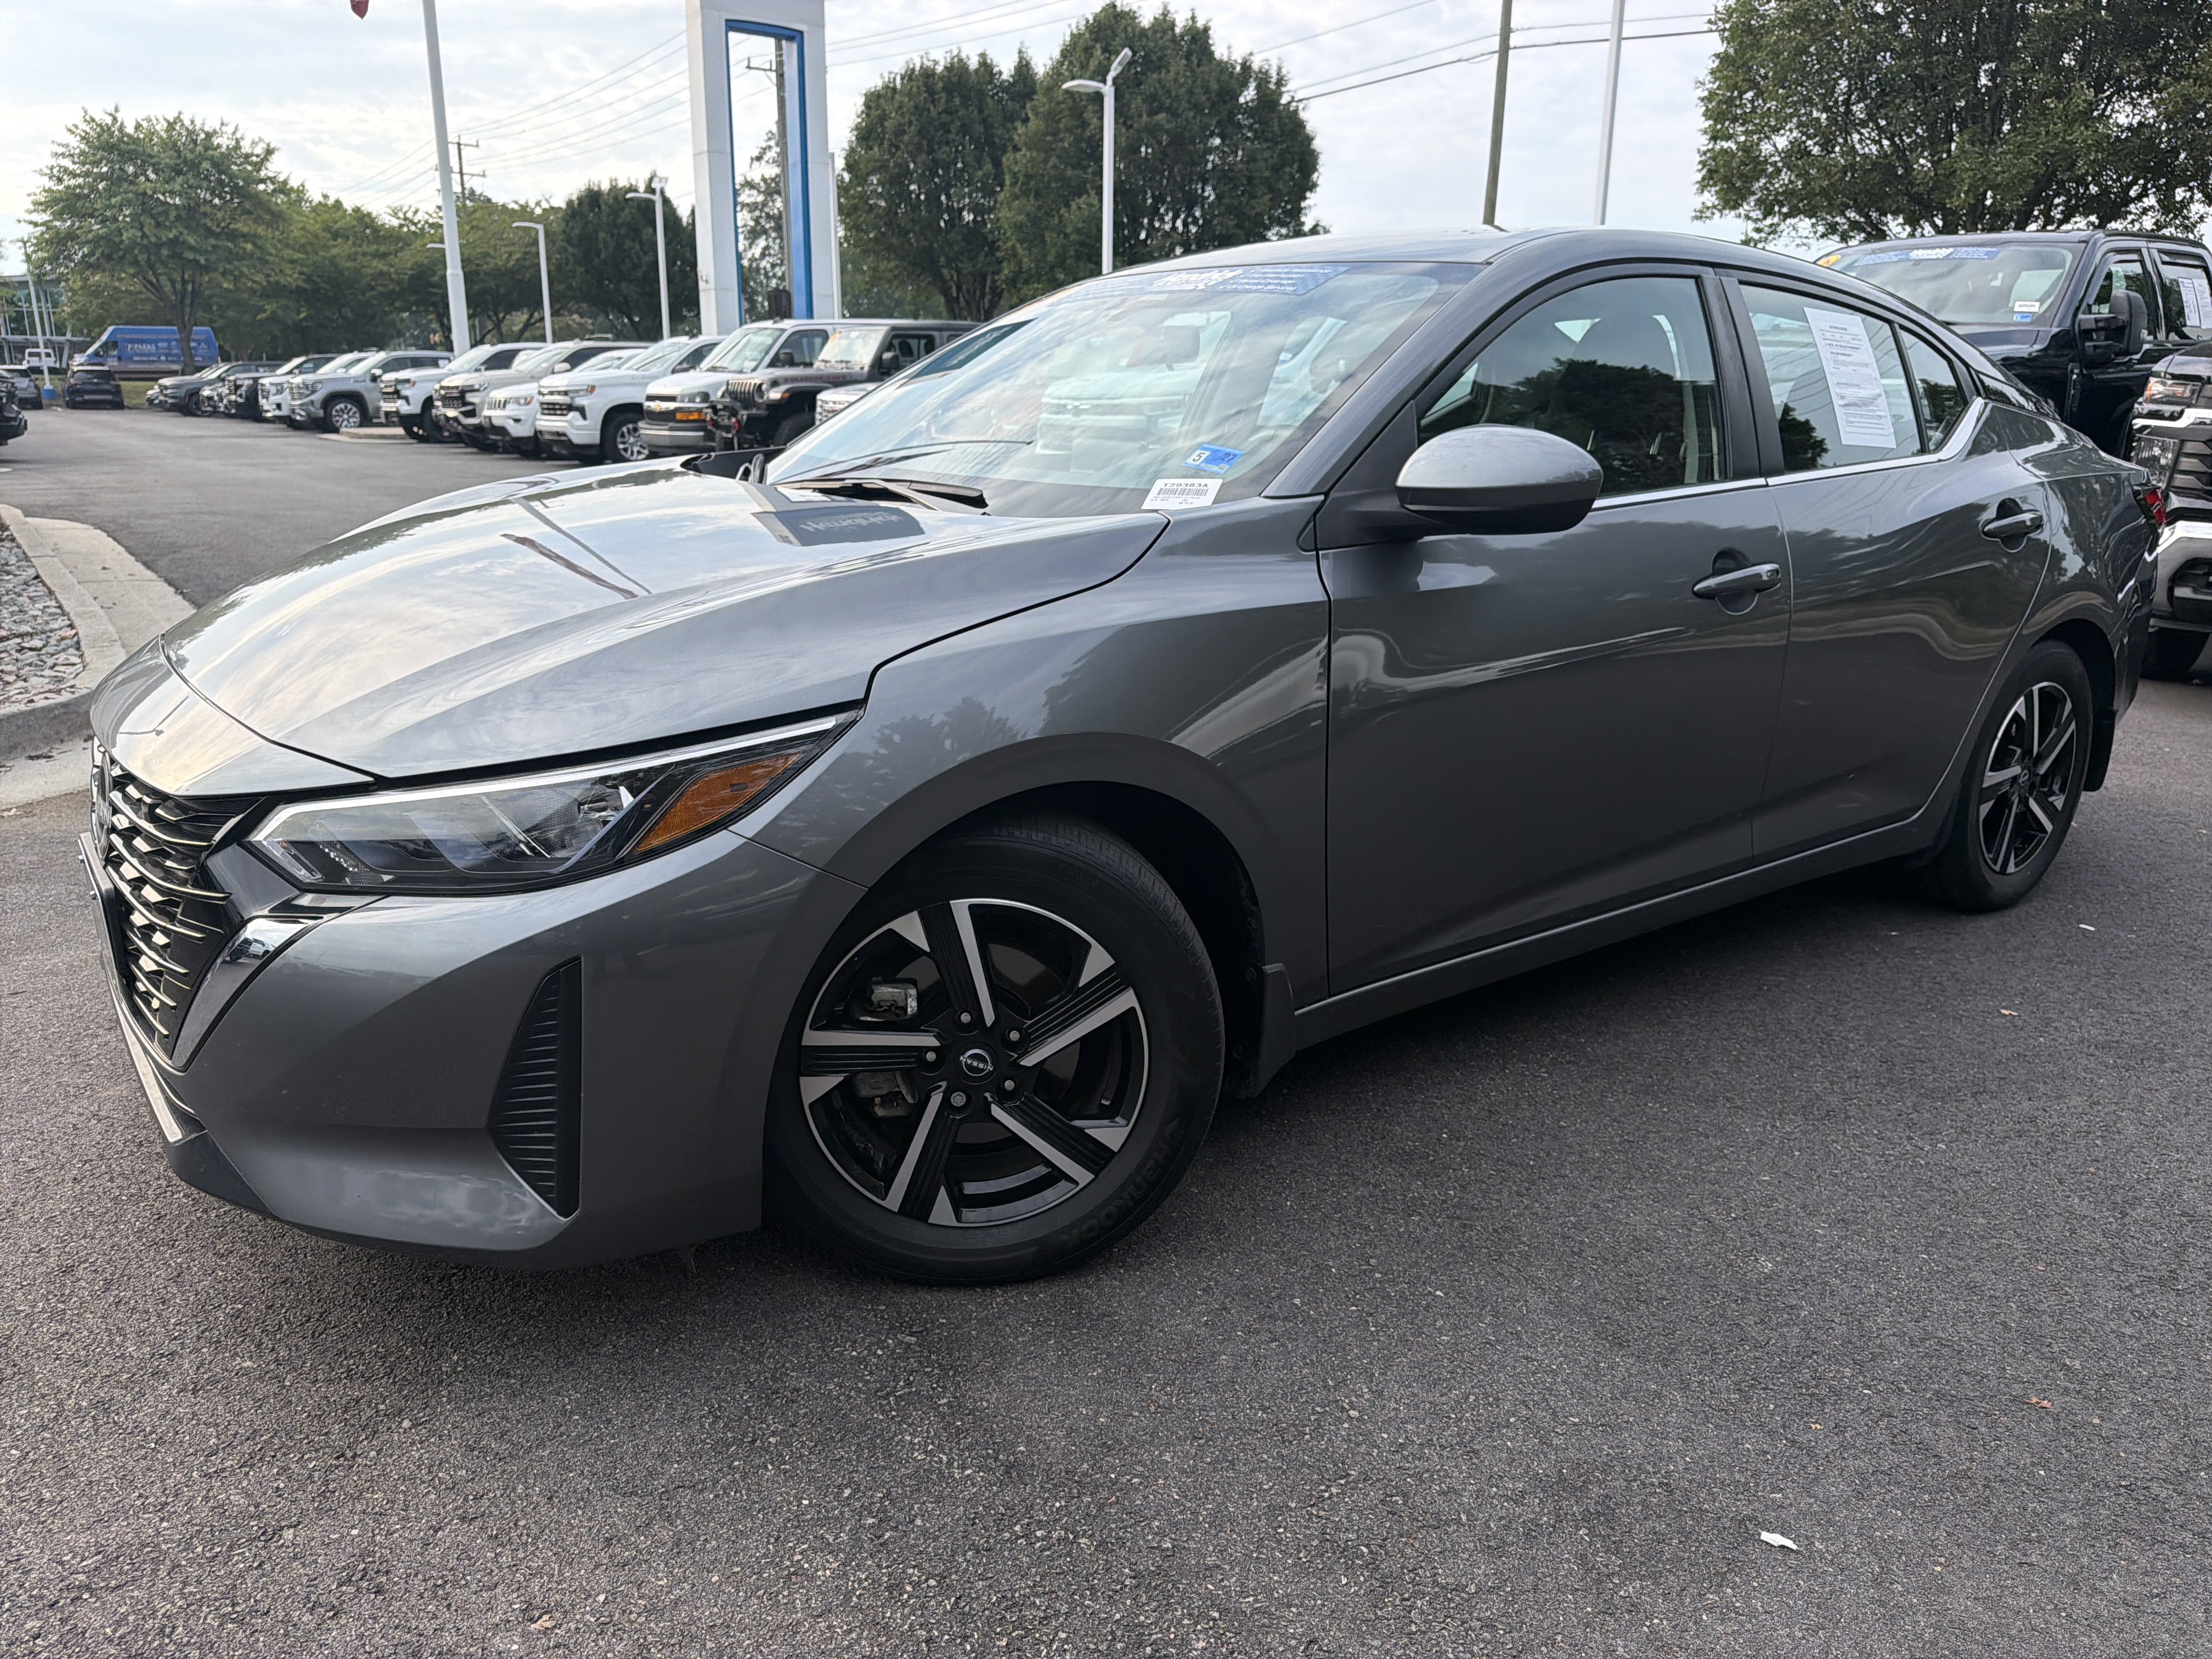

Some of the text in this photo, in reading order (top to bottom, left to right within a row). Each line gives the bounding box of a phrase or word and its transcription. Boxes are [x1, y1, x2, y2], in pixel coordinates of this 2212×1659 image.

[1192, 452, 1238, 462] 5 27
[959, 1054, 994, 1072] NISSAN
